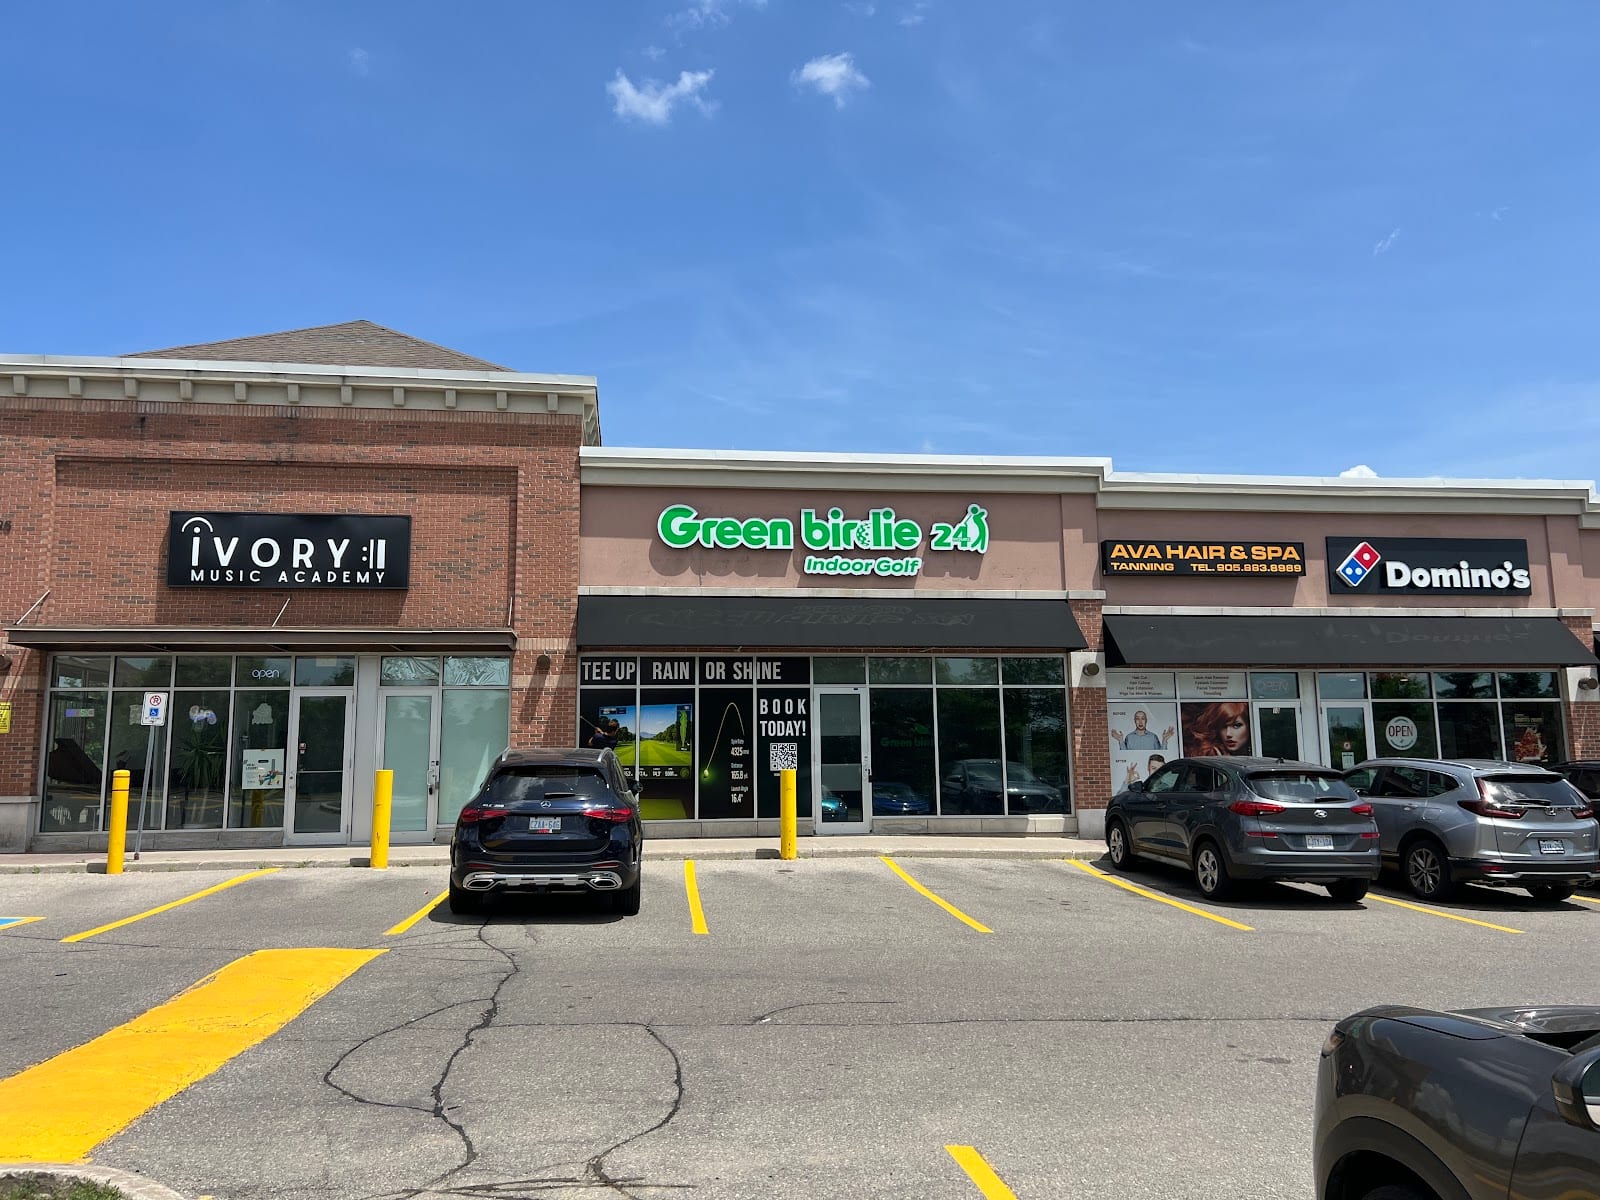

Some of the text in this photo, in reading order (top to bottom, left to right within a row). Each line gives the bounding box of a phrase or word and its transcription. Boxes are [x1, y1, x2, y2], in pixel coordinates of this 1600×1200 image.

[659, 505, 969, 549] Green birdie 24
[1110, 544, 1301, 561] AVA HAIR & SPA
[806, 557, 920, 575] Indoor Golf
[1110, 562, 1174, 571] TANNING
[1190, 563, 1215, 572] TEL.
[1384, 560, 1531, 589] Domino's
[189, 568, 385, 584] MUSIC ACADEMY
[251, 669, 280, 679] open
[582, 661, 782, 681] TEE UP RAIN OR SHINE
[759, 698, 807, 715] BOOK
[759, 720, 807, 737] TODAY!
[1388, 725, 1414, 737] OPEN
